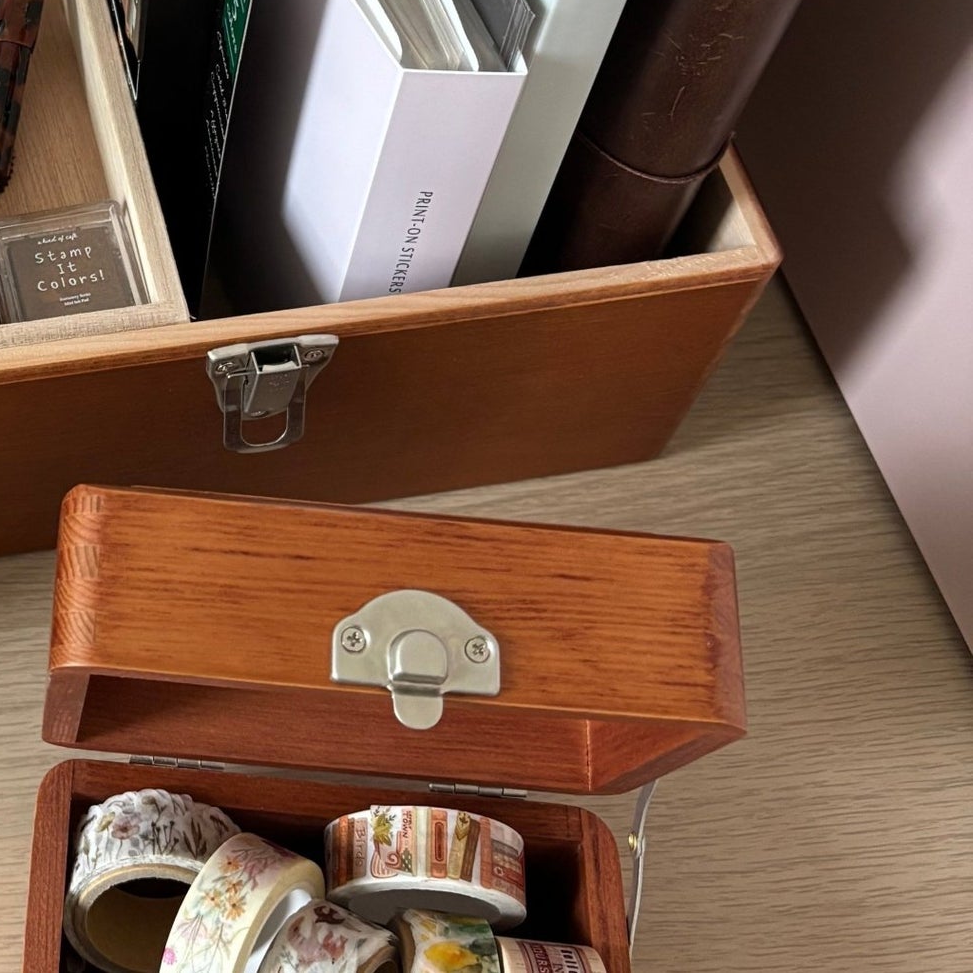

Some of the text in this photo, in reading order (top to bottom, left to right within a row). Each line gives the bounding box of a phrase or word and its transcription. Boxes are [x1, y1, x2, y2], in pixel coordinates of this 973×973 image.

[388, 190, 434, 294] PRINT-ON STICKERS
[34, 246, 92, 264] Stamp
[57, 261, 77, 275] It
[37, 269, 105, 292] Colors!
